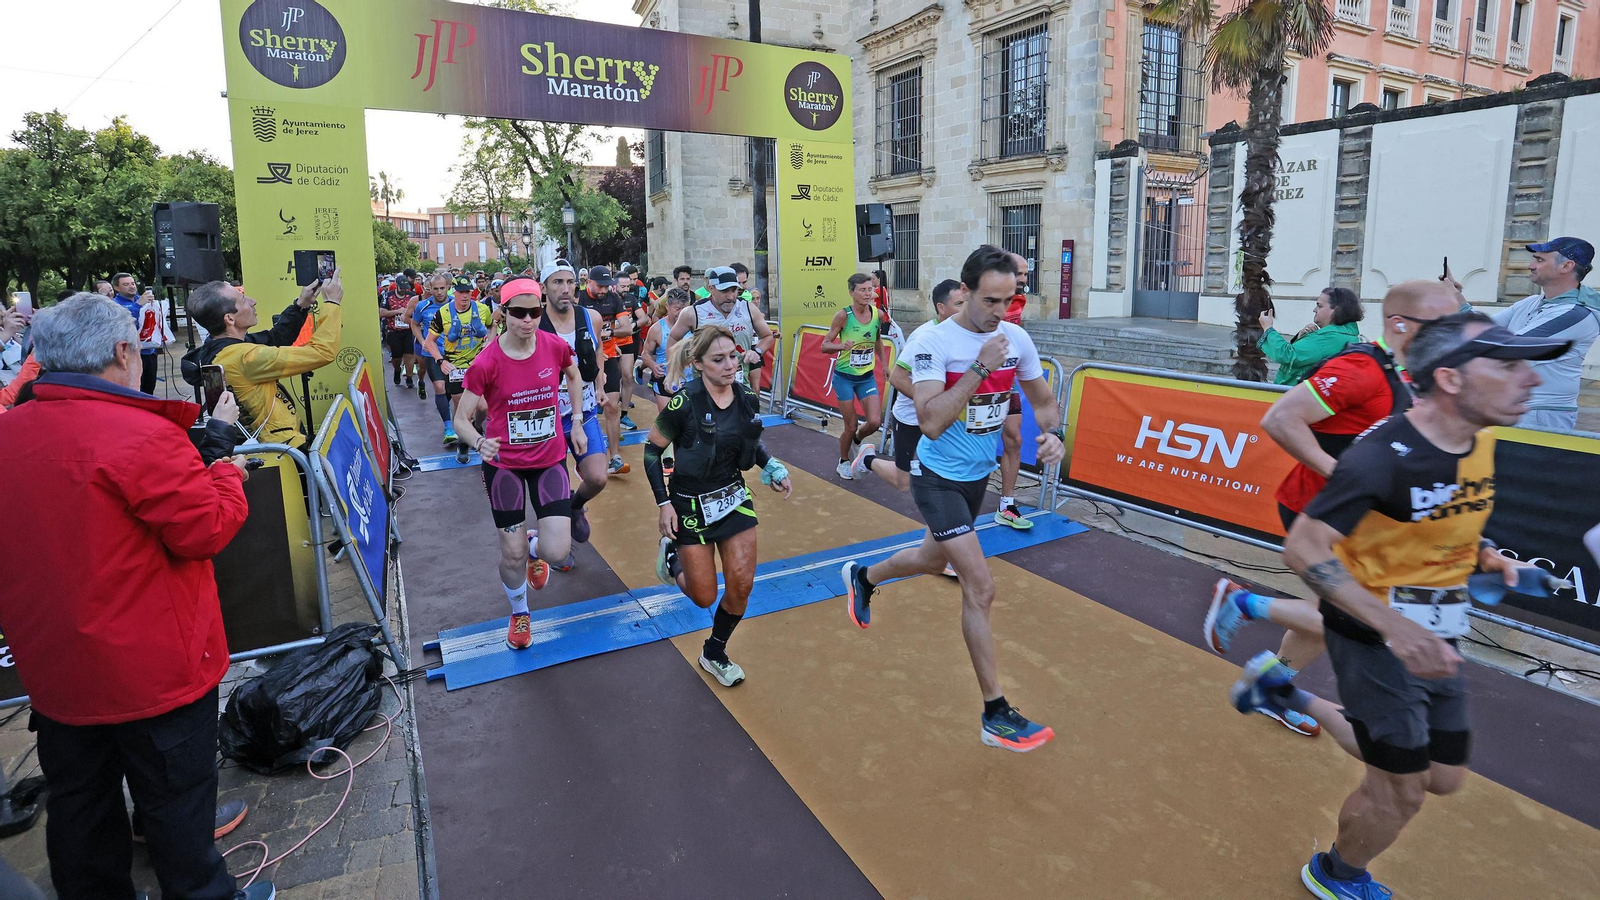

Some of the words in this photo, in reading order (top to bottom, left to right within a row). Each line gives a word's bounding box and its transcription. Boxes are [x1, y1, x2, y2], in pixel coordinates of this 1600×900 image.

[249, 28, 337, 60] Sherry
[266, 47, 325, 62] Maratón
[520, 41, 659, 99] Sherry
[547, 77, 640, 102] Maratón
[789, 86, 839, 110] Sherry
[798, 100, 832, 111] Maratón
[281, 118, 346, 130] Ayuntamiento
[282, 127, 294, 135] de
[296, 128, 319, 136] Jerez
[806, 152, 843, 160] Ayuntamiento
[295, 163, 349, 175] Diputación
[1276, 159, 1318, 174] AZAR
[297, 176, 310, 186] de
[313, 175, 340, 187] Cádiz
[812, 184, 844, 194] Diputación
[1275, 187, 1304, 200] REZ
[822, 193, 839, 202] Cádiz
[805, 256, 833, 267] HSN
[803, 301, 837, 309] SCALPERS
[512, 388, 539, 398] atletismo
[987, 404, 1001, 419] 20
[524, 418, 544, 432] 117
[1134, 415, 1250, 469] HSN
[1116, 453, 1134, 465] WE
[1138, 459, 1165, 472] ARE
[1170, 466, 1261, 495] NUTRITION!
[717, 494, 736, 513] 230
